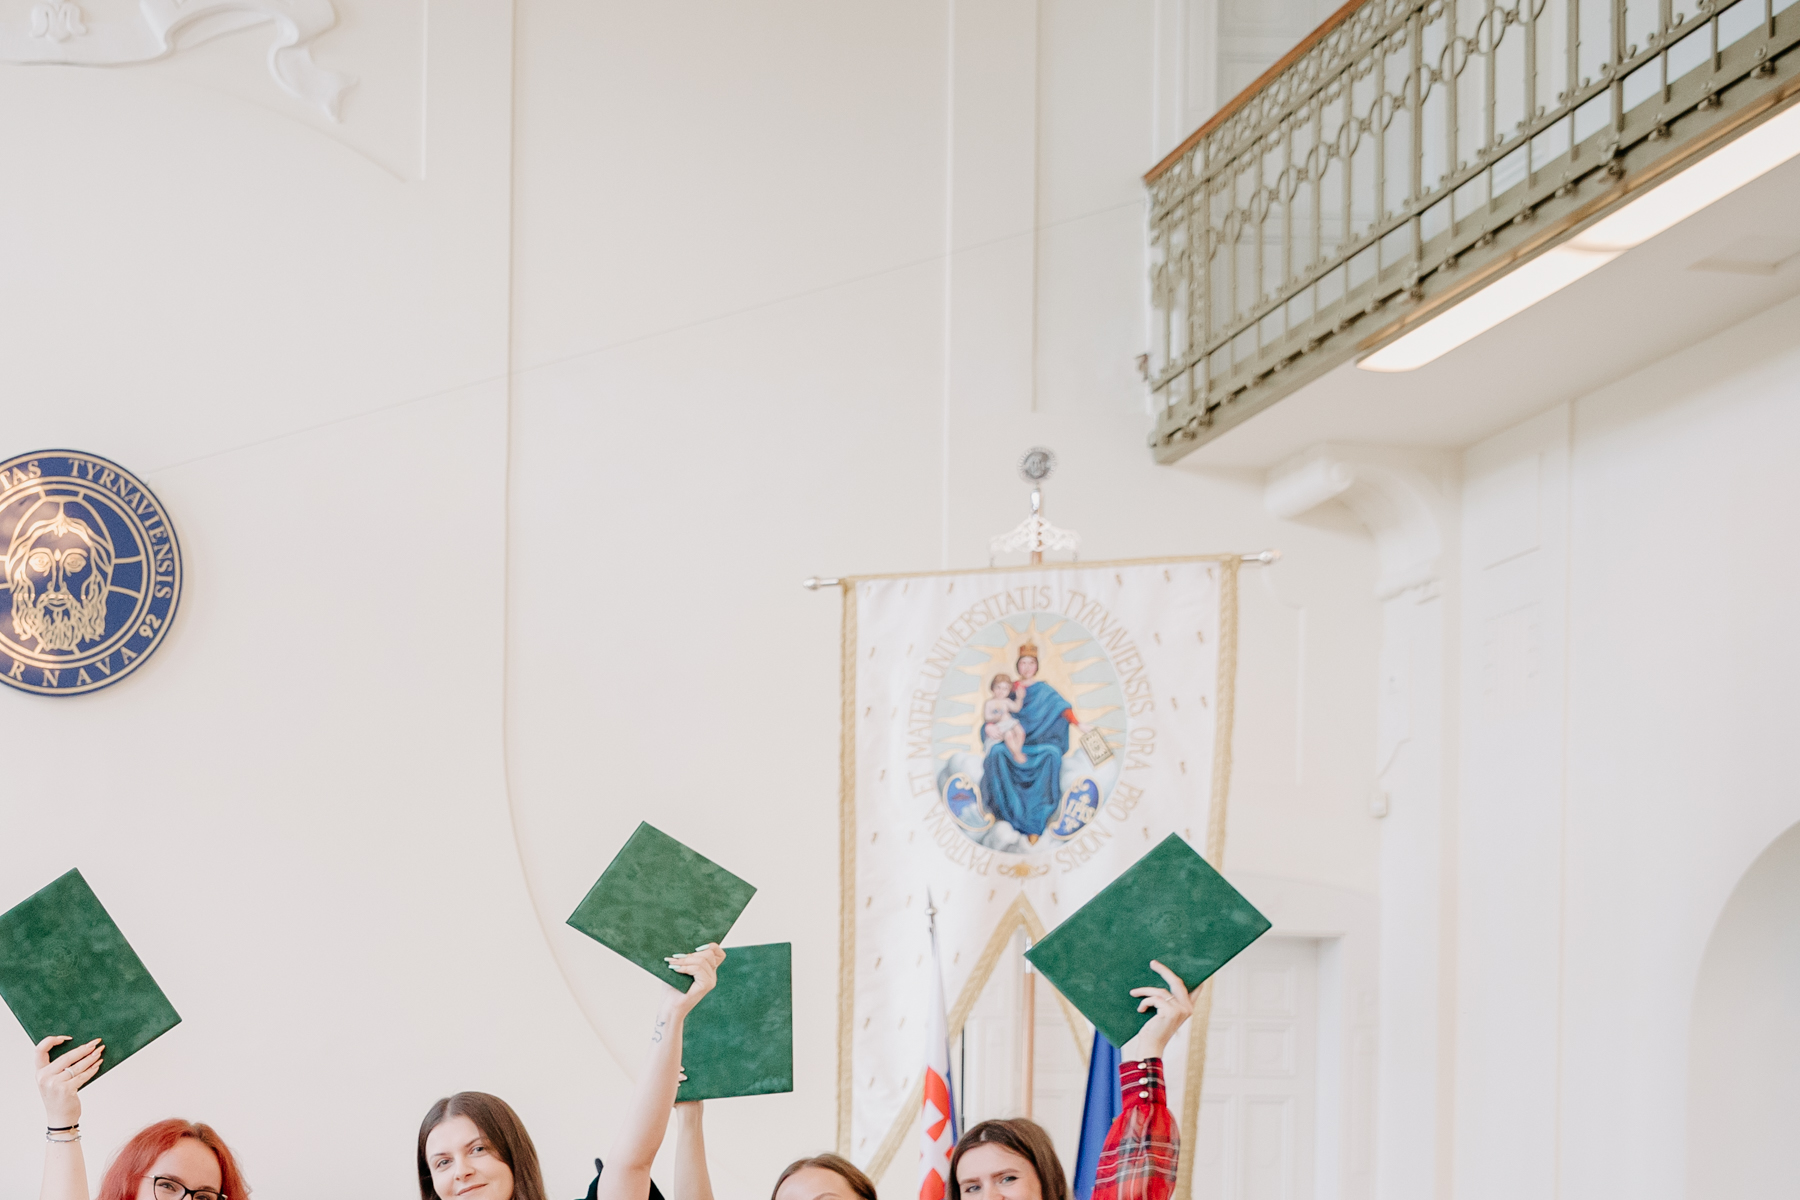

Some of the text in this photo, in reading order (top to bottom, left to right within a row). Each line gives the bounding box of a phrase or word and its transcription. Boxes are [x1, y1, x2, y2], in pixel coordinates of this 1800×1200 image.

[68, 458, 174, 599] TYRNAVIENSIS
[138, 614, 162, 639] 92
[921, 585, 1052, 685] UNIVERSITATIS
[1064, 589, 1154, 718] TYRNAVIENSIS
[907, 688, 938, 760] MATER
[1125, 727, 1156, 772] ORA
[908, 770, 935, 799] ET
[1106, 781, 1145, 823] PRO
[922, 800, 995, 876] PATRONA
